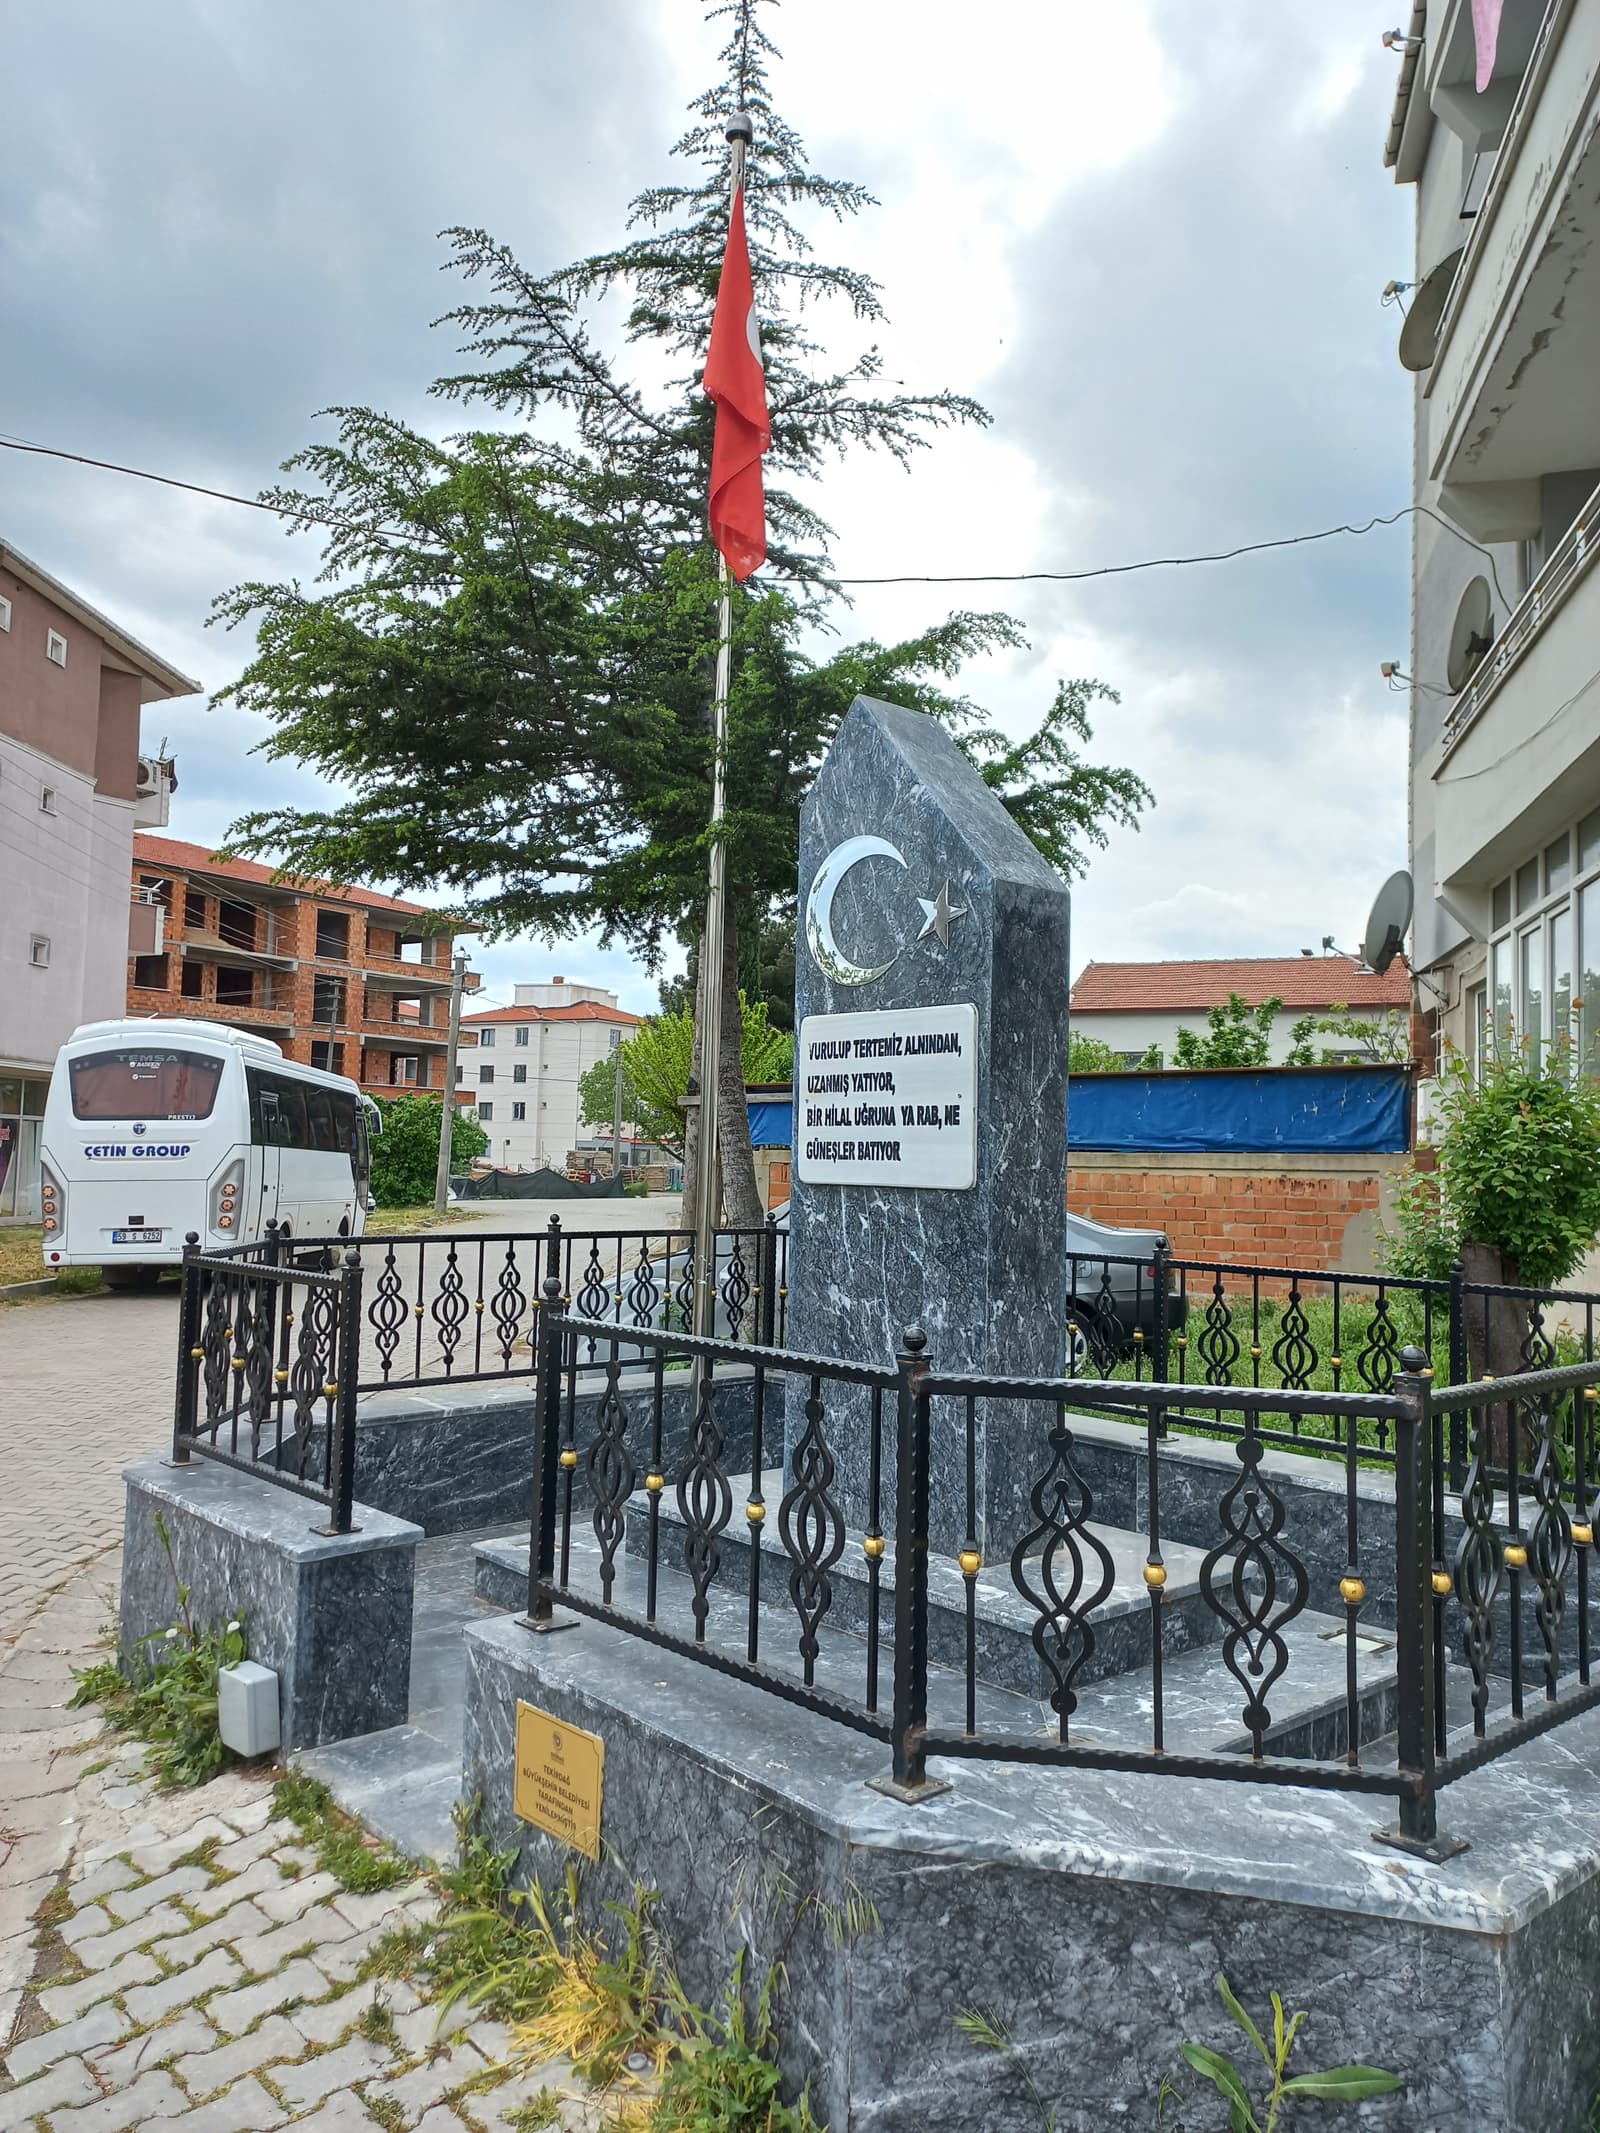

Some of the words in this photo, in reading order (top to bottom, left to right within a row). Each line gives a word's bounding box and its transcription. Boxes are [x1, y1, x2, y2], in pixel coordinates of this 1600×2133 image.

[116, 1054, 178, 1062] TEMSA
[808, 1040, 851, 1060] VURULUP
[853, 1032, 902, 1058] TERTEMİZ
[904, 1032, 961, 1057] ALNINDAN,
[807, 1073, 849, 1097] UZANMIŞ
[851, 1071, 895, 1095] YATIYOR,
[806, 1104, 822, 1127] BİR
[824, 1103, 852, 1126] HİLAL
[854, 1102, 896, 1126] UĞRUNA
[901, 1105, 914, 1126] YA
[916, 1105, 942, 1130] RAB,
[944, 1105, 960, 1126] NE
[84, 1143, 127, 1160] ÇETİN
[132, 1145, 191, 1157] GROUP
[806, 1137, 855, 1163] GÜNEŞLER
[857, 1140, 901, 1161] BATIYOR
